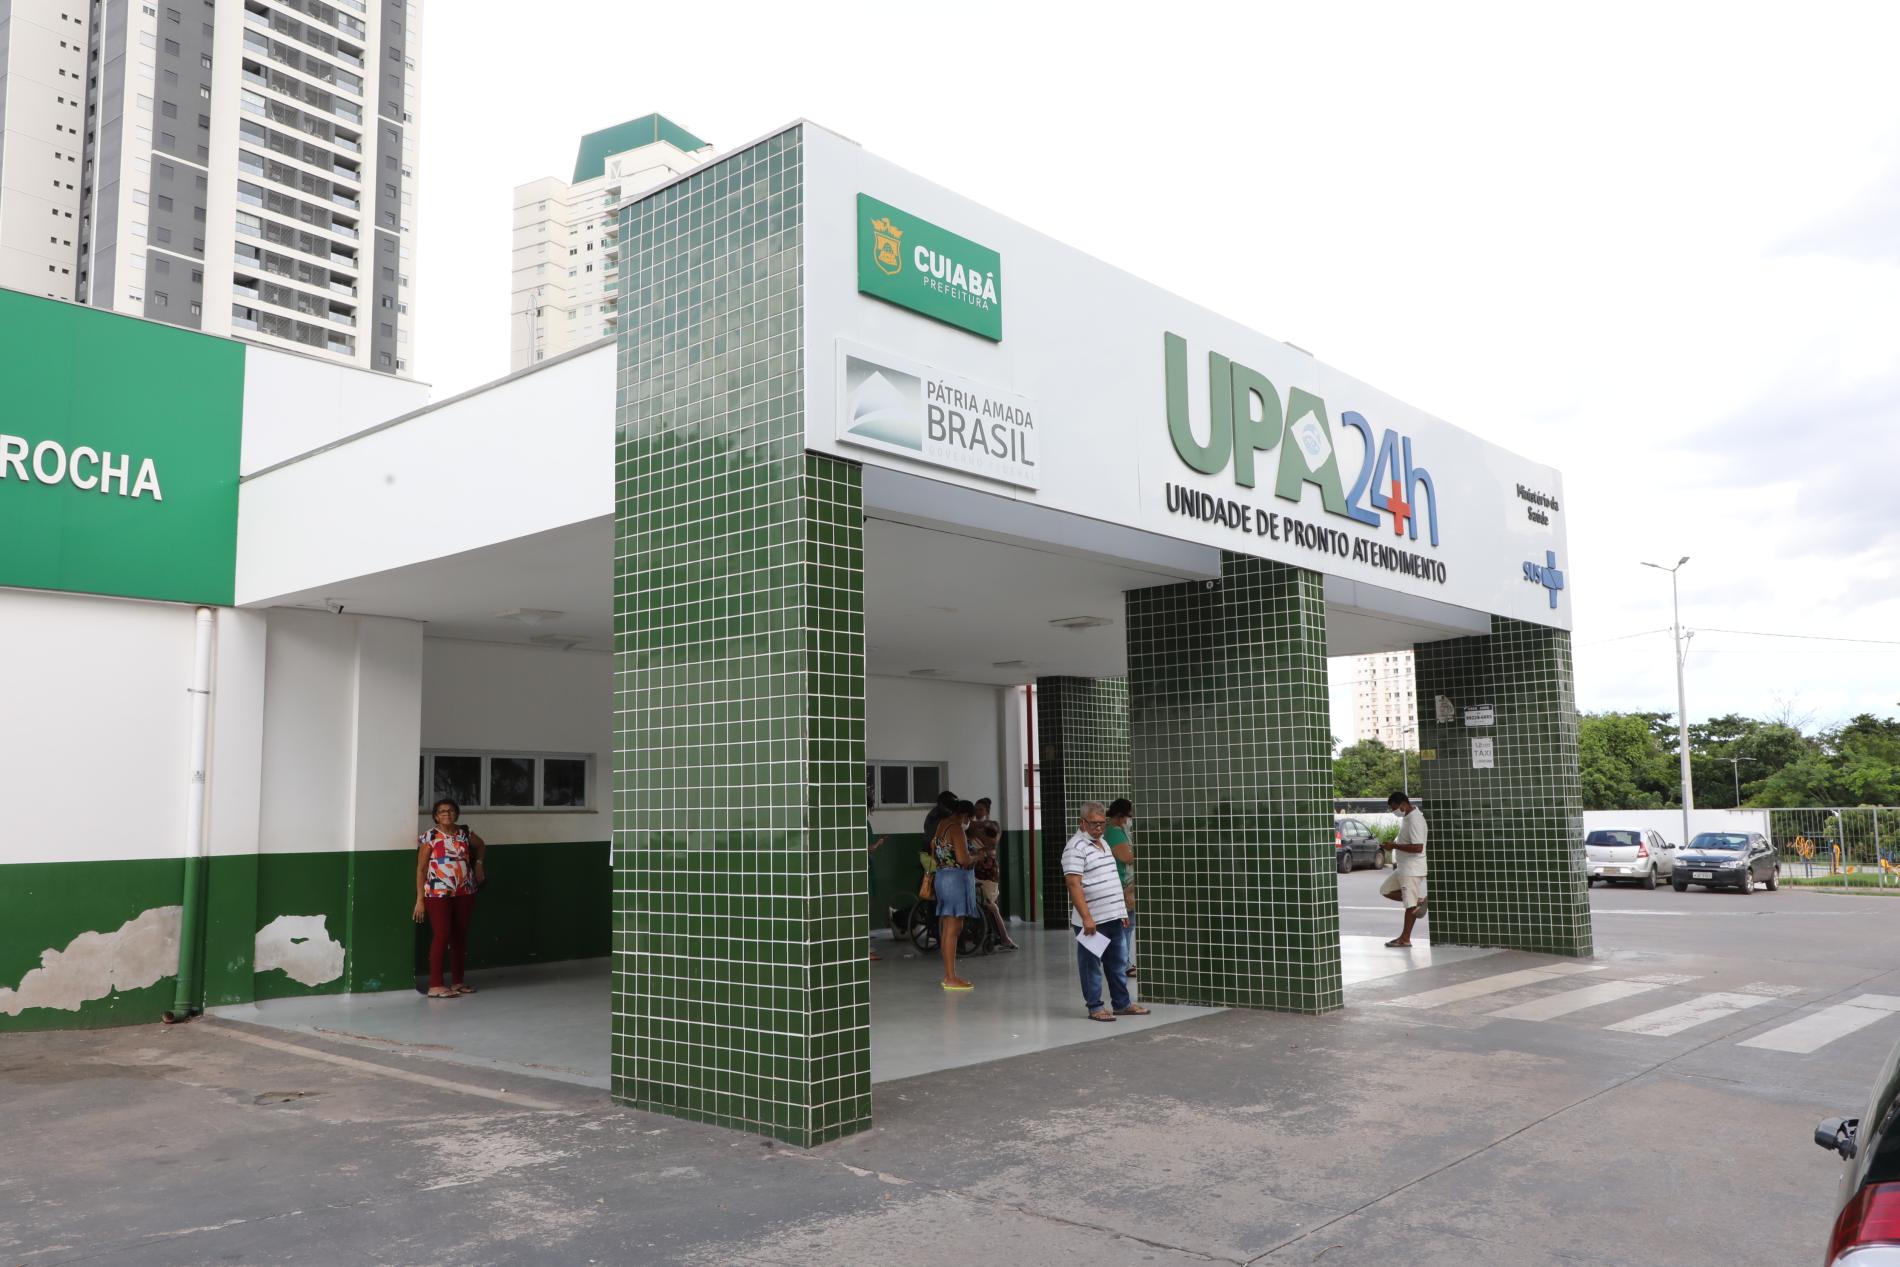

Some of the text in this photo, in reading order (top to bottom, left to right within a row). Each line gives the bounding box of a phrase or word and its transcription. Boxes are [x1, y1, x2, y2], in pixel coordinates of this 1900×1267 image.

[913, 245, 998, 305] CUIABÁ
[923, 275, 989, 311] PREFEITURA
[927, 380, 1033, 430] PÁTRIA AMADA
[927, 403, 1035, 467] BRASIL
[1164, 331, 1439, 546] UPA 24h
[0, 434, 163, 501] ROCHA
[1527, 505, 1549, 526] Saúde
[1550, 496, 1559, 511] da
[1165, 482, 1447, 584] UNIDADE DE PRONTO ATENDIMENTO
[1522, 561, 1541, 584] SUS
